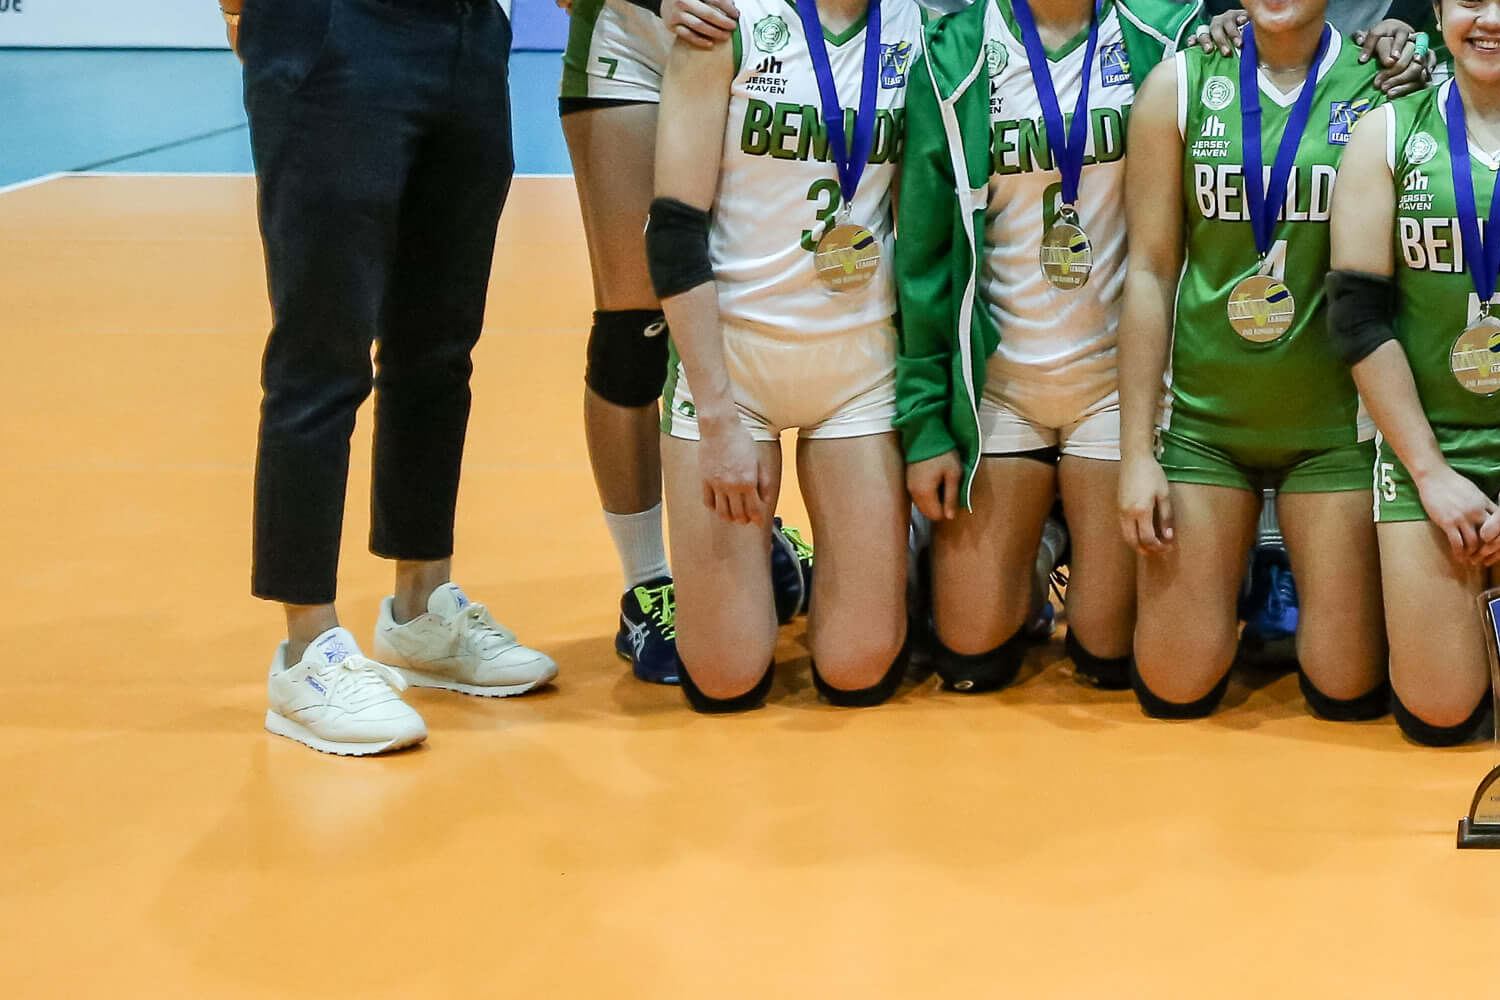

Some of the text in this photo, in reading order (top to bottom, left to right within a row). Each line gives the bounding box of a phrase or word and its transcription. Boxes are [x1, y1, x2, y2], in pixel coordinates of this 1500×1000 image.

[598, 56, 618, 79] 7
[746, 76, 788, 87] JERSEY
[746, 84, 786, 95] HAVEN
[1192, 141, 1231, 149] JERSEY
[1192, 149, 1228, 157] HAVEN
[801, 179, 841, 252] 3
[1381, 462, 1398, 502] 5
